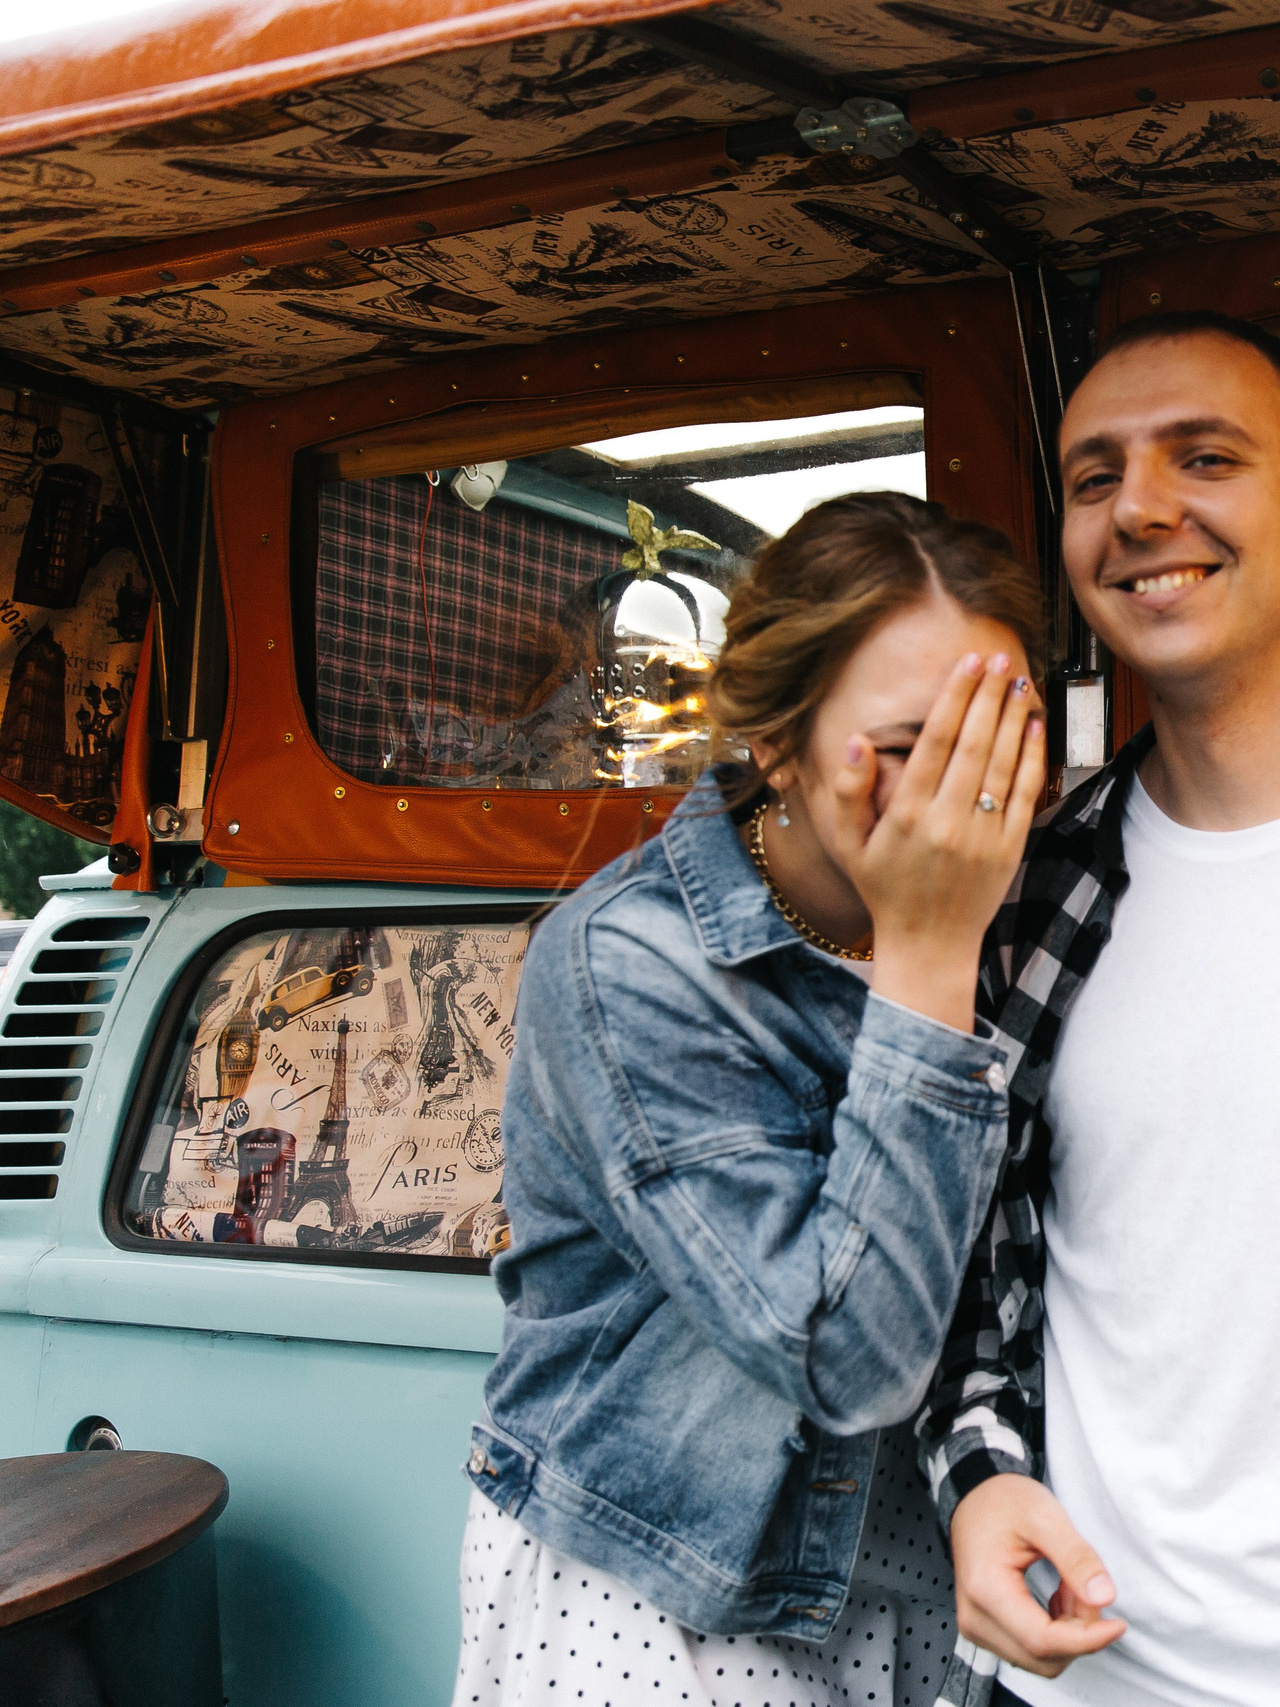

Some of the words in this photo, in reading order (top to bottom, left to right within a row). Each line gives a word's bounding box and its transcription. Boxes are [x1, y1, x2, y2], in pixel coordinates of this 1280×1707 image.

[1125, 118, 1168, 152] NEW
[532, 229, 562, 258] NEW
[37, 433, 62, 451] AIR
[298, 1013, 368, 1033] Naxiesi
[373, 1021, 387, 1033] as
[470, 992, 501, 1028] NEW
[368, 1070, 390, 1105] MOROCCO
[226, 1102, 250, 1126] AIR
[413, 1103, 476, 1122] obsessed
[364, 1140, 458, 1202] PARIS
